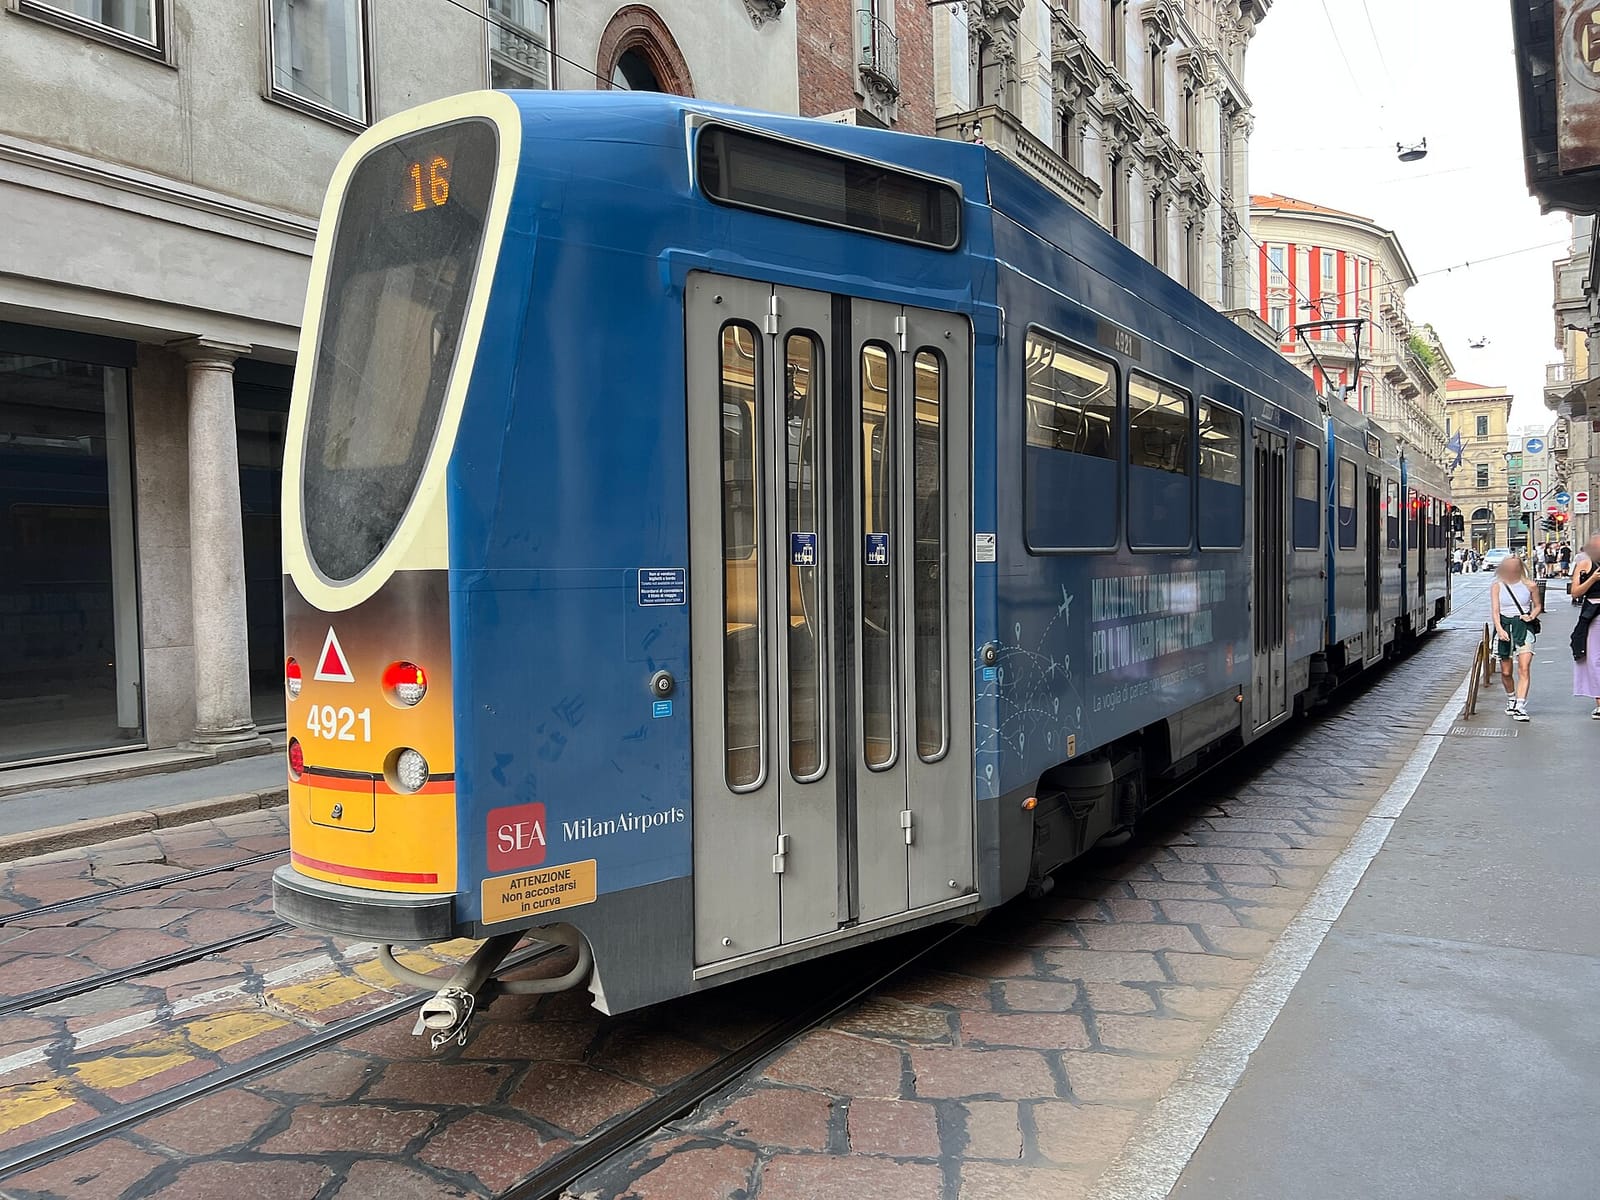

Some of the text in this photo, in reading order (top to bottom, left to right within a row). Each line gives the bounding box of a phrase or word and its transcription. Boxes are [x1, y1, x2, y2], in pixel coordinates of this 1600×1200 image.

[411, 157, 449, 212] 16
[1115, 330, 1132, 356] 4921
[1092, 630, 1107, 675] PER
[306, 704, 371, 743] 4921
[497, 807, 685, 853] SEA MilanAirports
[502, 880, 577, 904] Non accostarsi
[510, 869, 571, 890] ATTENZIONE
[521, 897, 561, 913] in curva
